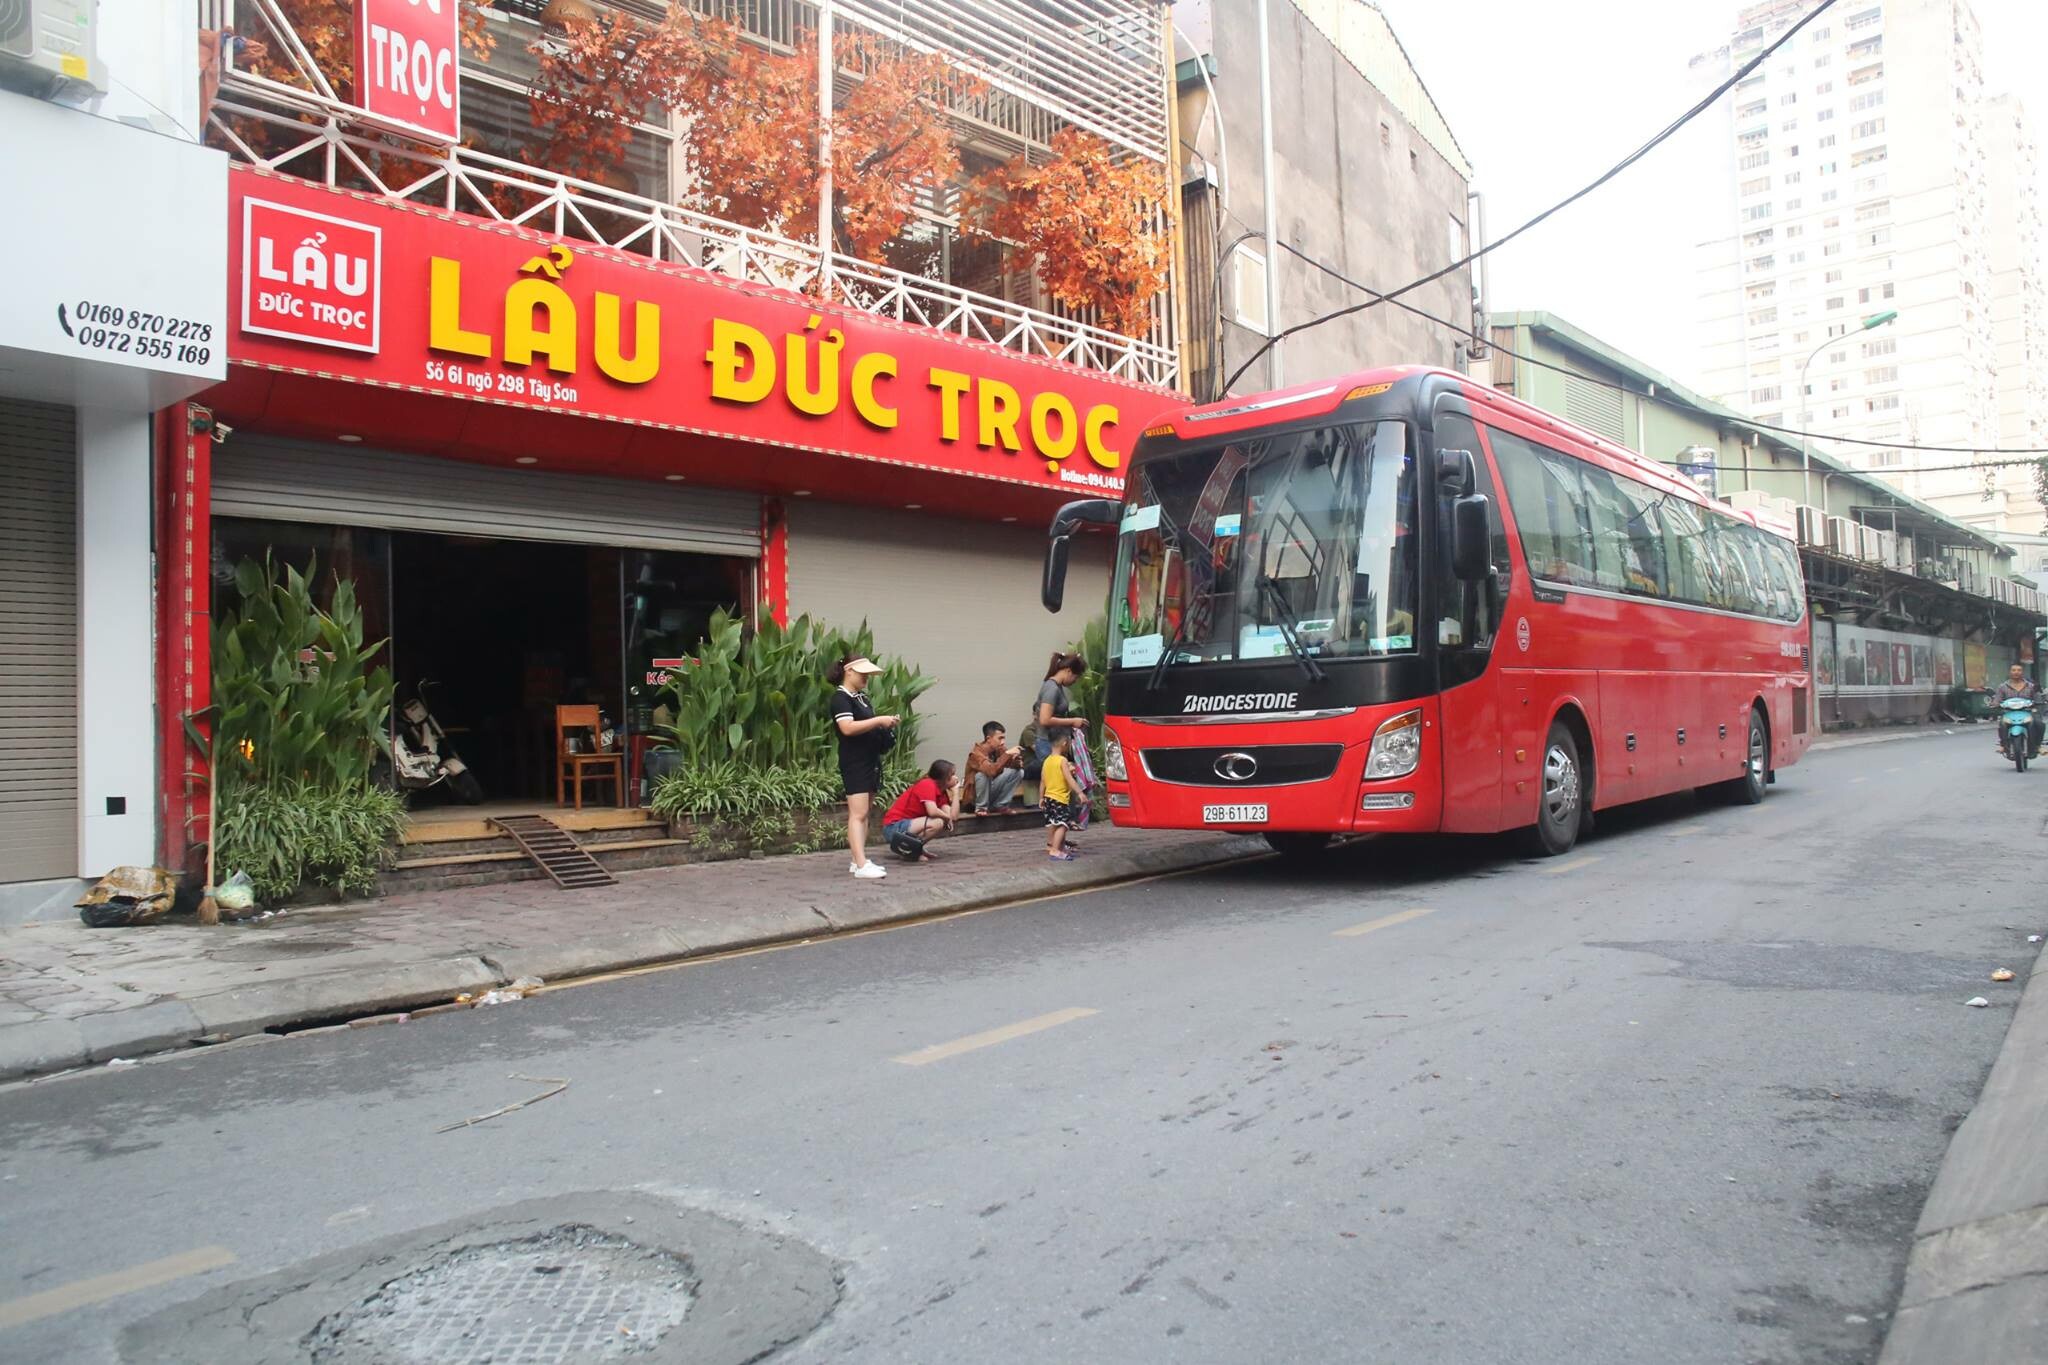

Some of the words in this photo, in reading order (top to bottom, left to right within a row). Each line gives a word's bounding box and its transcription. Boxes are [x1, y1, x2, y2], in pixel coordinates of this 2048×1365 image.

[371, 23, 452, 116] TRỌC
[259, 231, 368, 297] LẨU
[76, 300, 124, 326] 0169
[127, 311, 164, 334] 870
[166, 318, 212, 342] 2278
[258, 291, 304, 318] ĐỨC
[310, 301, 366, 330] TRỌC
[79, 326, 131, 352] 0972
[135, 337, 173, 360] 555
[177, 345, 210, 366] 169
[430, 244, 660, 384] LẨU
[705, 314, 898, 428] ĐỨC
[929, 367, 1120, 473] TRỌC
[425, 361, 444, 381] Số
[466, 372, 492, 392] ngõ
[497, 373, 524, 394] 298
[529, 378, 551, 402] Tây
[553, 383, 577, 402] Sơn
[1182, 692, 1298, 713] BRIDGESTONE
